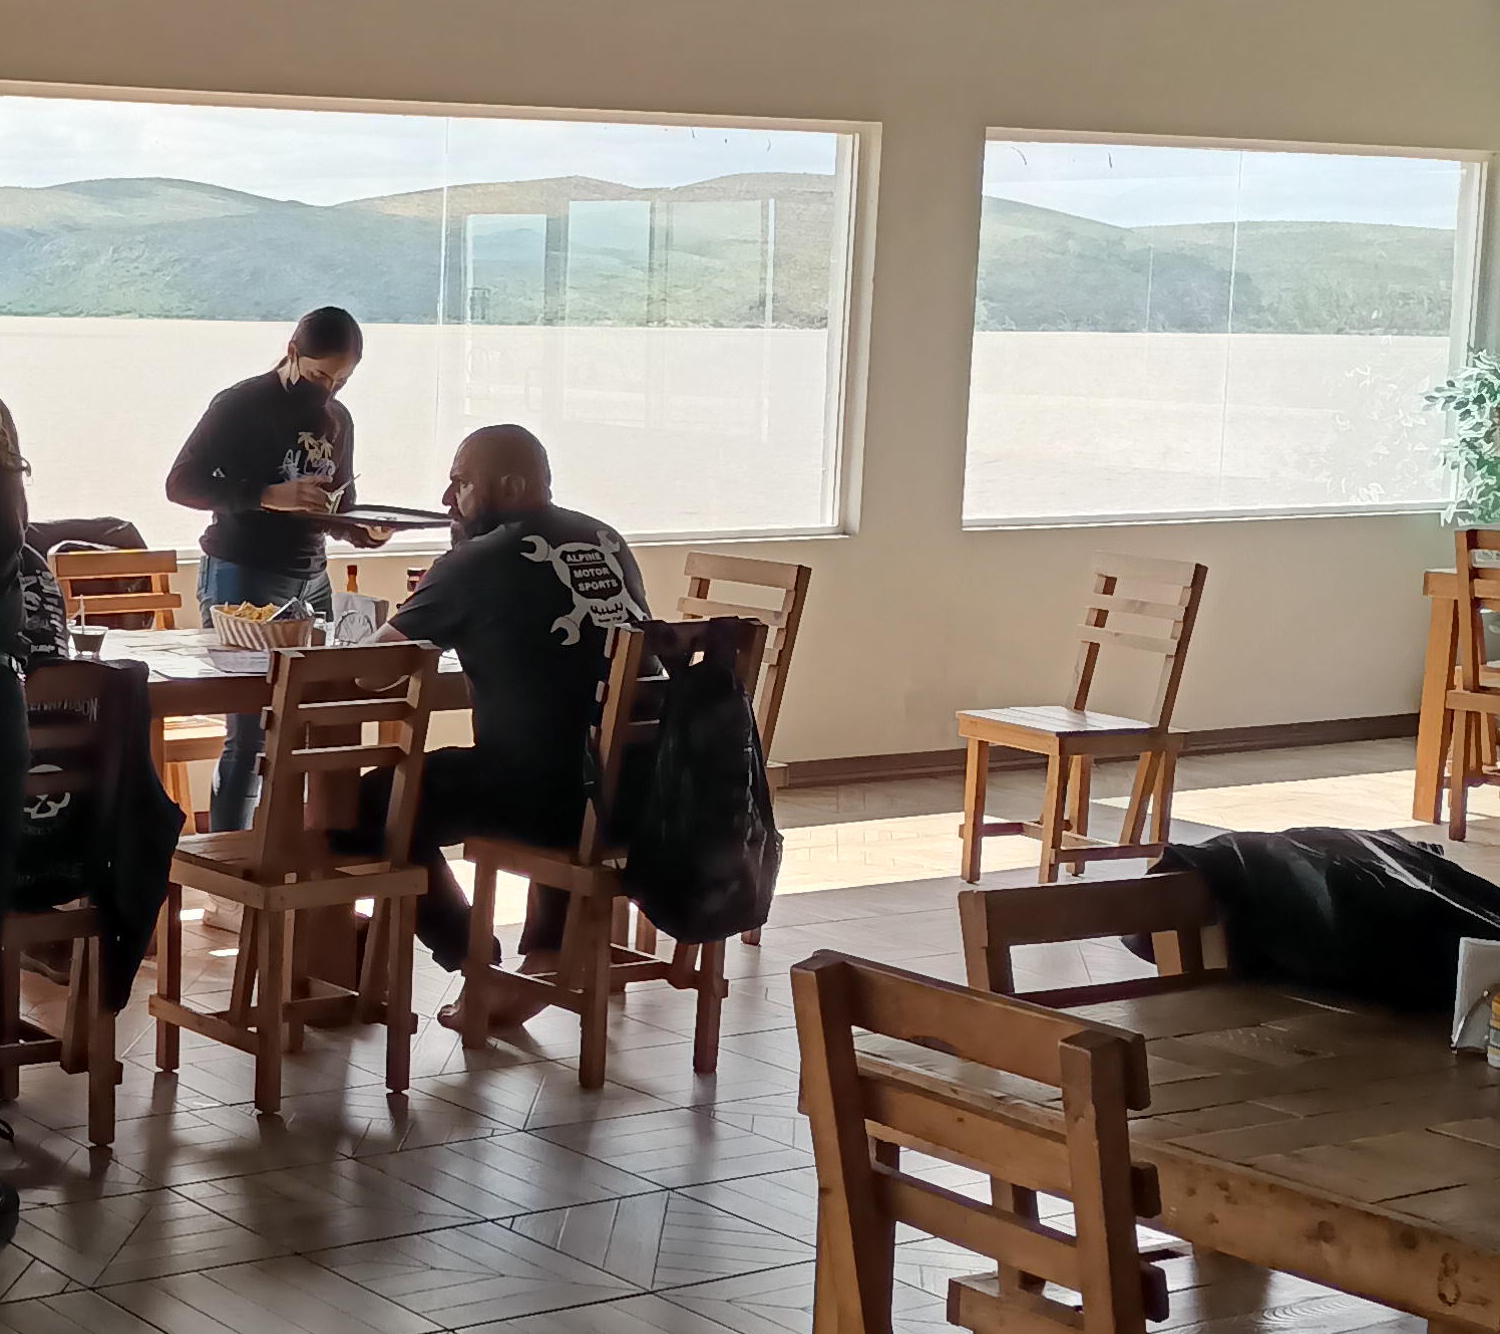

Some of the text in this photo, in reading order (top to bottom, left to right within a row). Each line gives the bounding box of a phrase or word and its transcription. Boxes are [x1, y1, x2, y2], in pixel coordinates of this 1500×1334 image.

[566, 552, 602, 562] ALPINE
[573, 567, 610, 579] MOTOR
[578, 579, 618, 591] SPORTS
